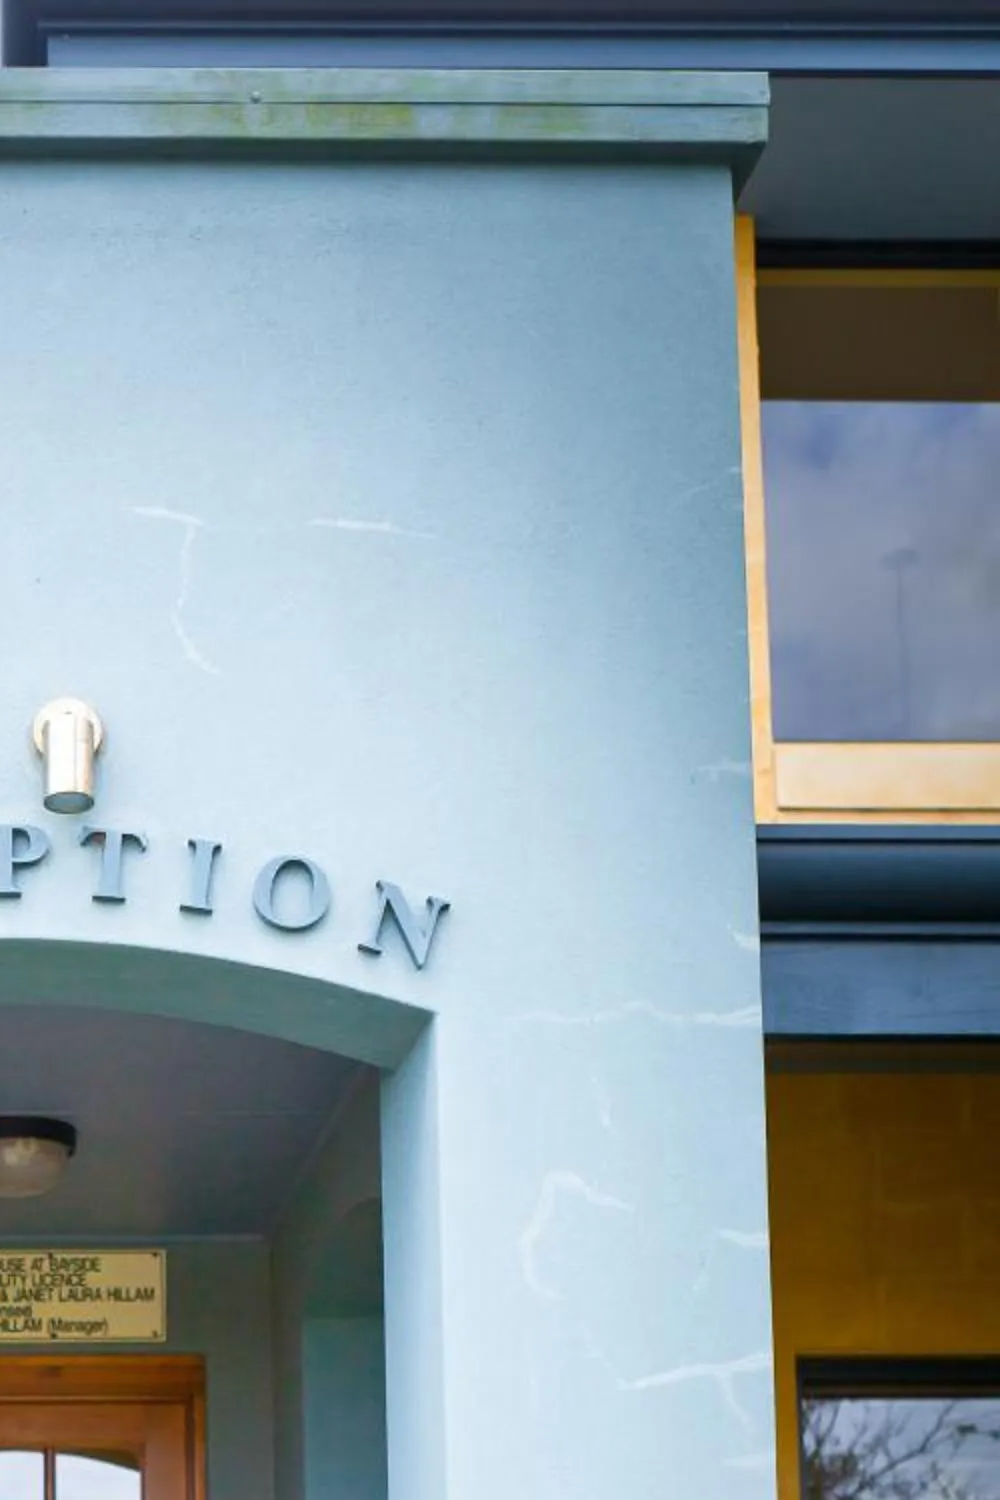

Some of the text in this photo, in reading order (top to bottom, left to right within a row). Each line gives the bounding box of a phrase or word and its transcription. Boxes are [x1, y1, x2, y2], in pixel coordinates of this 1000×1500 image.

[30, 1258, 45, 1273] AT
[50, 1257, 102, 1273] BAYSIDE
[31, 1273, 87, 1287] LICENCE
[0, 1288, 9, 1302] &
[13, 1287, 54, 1302] JANET
[59, 1287, 101, 1302] LAURA
[105, 1287, 155, 1302] HILLAM
[47, 1316, 109, 1336] (Manager)
